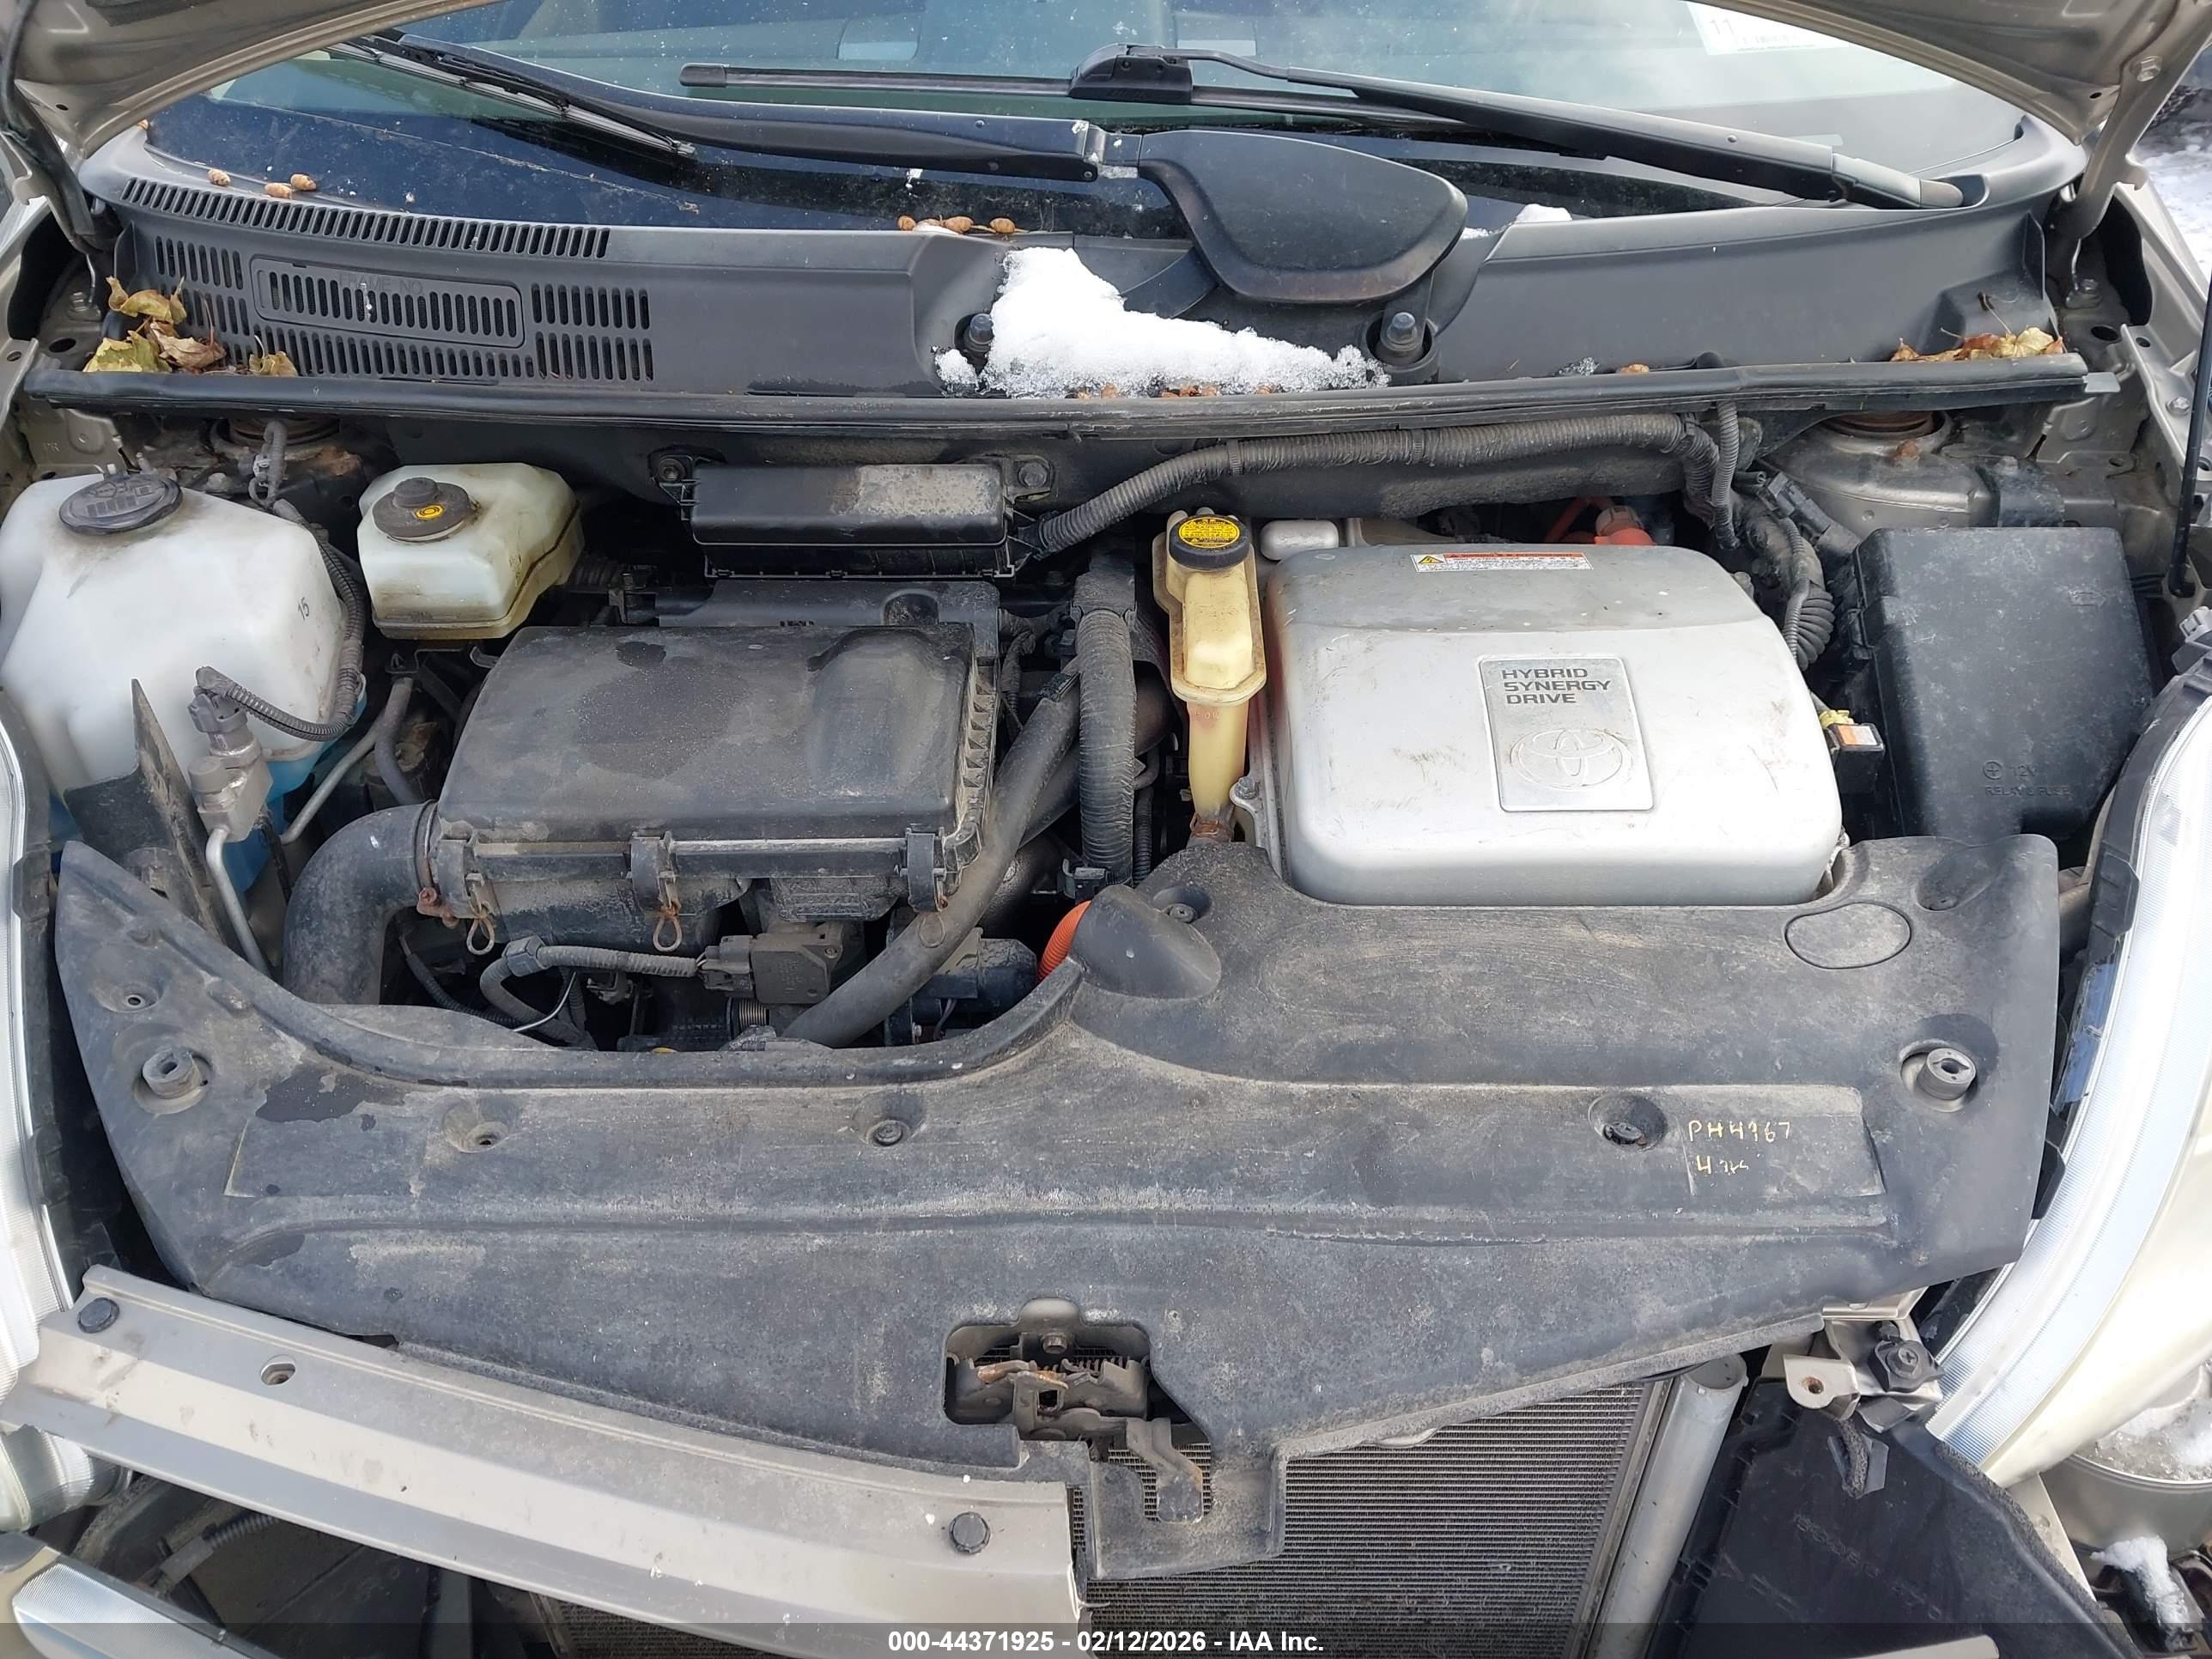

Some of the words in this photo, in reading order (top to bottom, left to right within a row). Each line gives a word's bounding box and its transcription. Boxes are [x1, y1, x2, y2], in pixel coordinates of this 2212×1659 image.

[338, 273, 392, 292] FRAME
[297, 597, 310, 621] 15
[1503, 668, 1588, 679] HYBRID
[1504, 680, 1611, 692] SYNERGY
[1507, 693, 1577, 704] DRIVE
